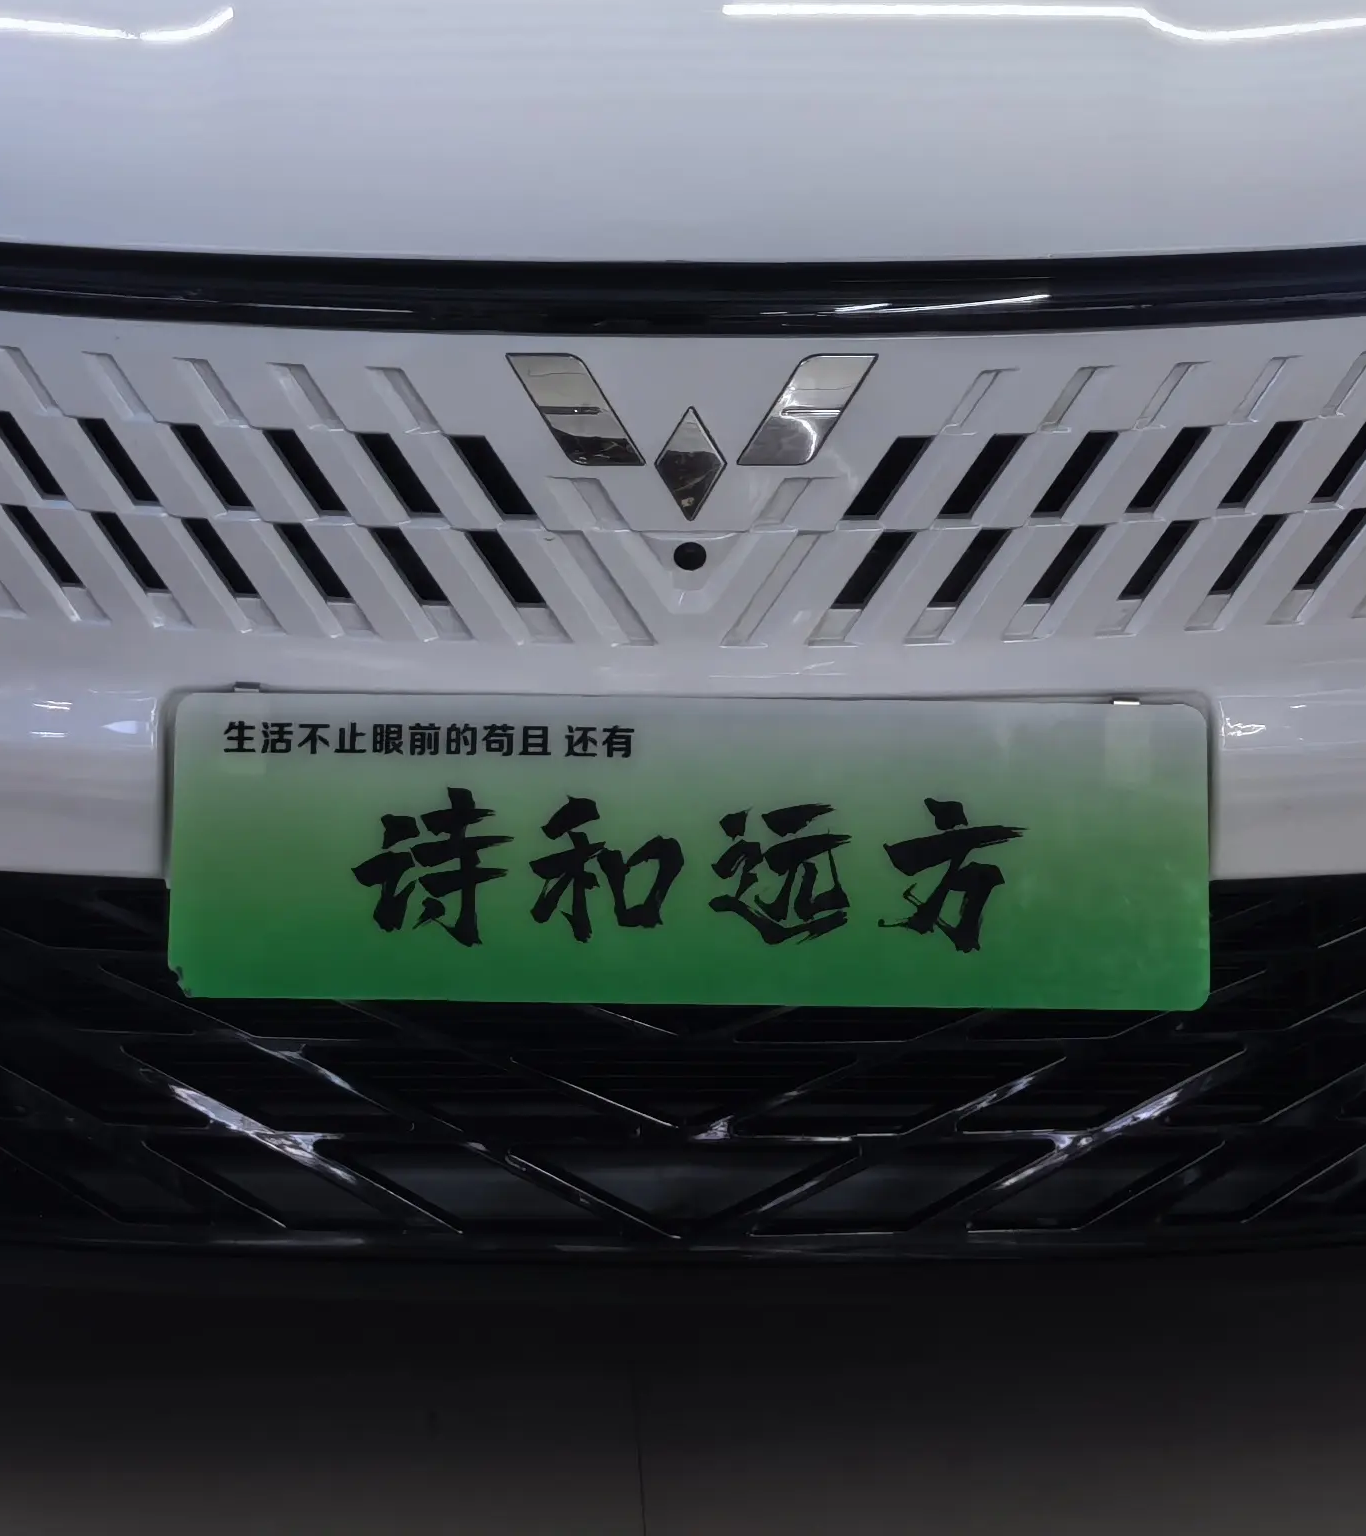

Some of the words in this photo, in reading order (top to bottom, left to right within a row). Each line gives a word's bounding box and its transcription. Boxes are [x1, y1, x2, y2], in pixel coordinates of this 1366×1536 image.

[223, 720, 553, 757] 生活不止眼前的苟且
[563, 723, 637, 758] 还有
[350, 786, 1031, 954] 诗和远方
